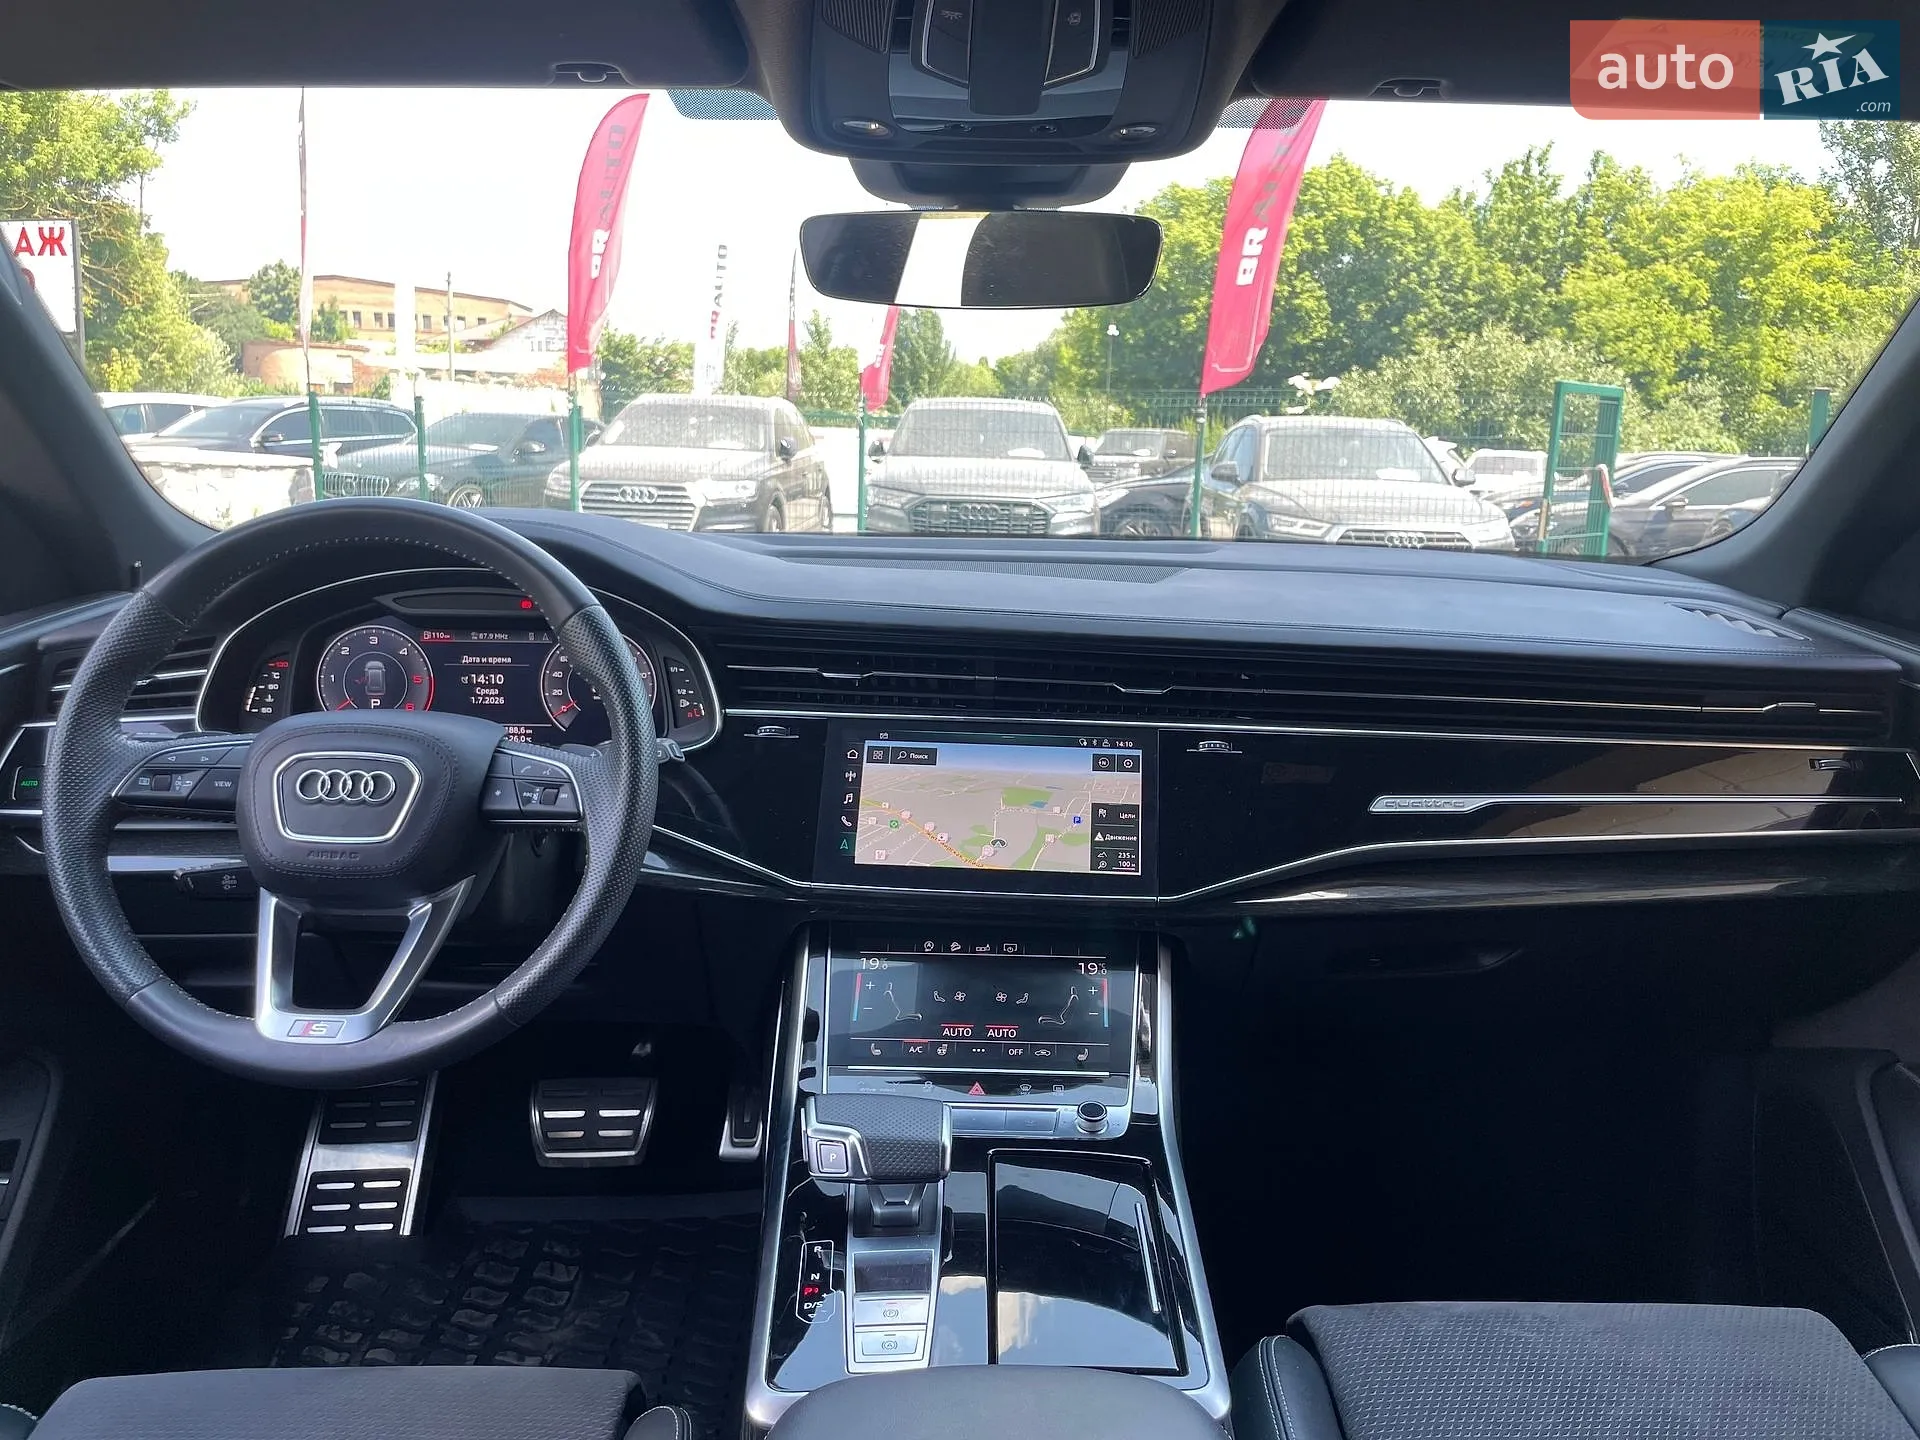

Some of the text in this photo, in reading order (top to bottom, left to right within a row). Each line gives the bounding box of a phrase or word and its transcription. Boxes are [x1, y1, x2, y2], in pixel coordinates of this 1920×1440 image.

[369, 636, 378, 645] 3
[341, 647, 350, 655] 2
[400, 647, 408, 655] 4
[462, 655, 480, 663] Дата
[488, 657, 512, 665] время
[330, 674, 335, 683] 1
[413, 676, 422, 684] 5
[471, 674, 504, 685] 14:10
[475, 687, 499, 696] Среда
[371, 699, 381, 709] P
[471, 696, 505, 705] 1.7.2026
[909, 752, 929, 760] Поиск
[214, 780, 232, 788] VIEW
[1384, 799, 1465, 809] quattro
[1119, 812, 1136, 820] Цели
[1105, 833, 1137, 841] Движение
[307, 850, 360, 861] AIRBAG
[1119, 860, 1131, 868] 100
[942, 1027, 1017, 1038] AUTO AUTO
[1008, 1048, 1024, 1056] OFF
[830, 1153, 837, 1163] P
[804, 1301, 824, 1310] D/S
